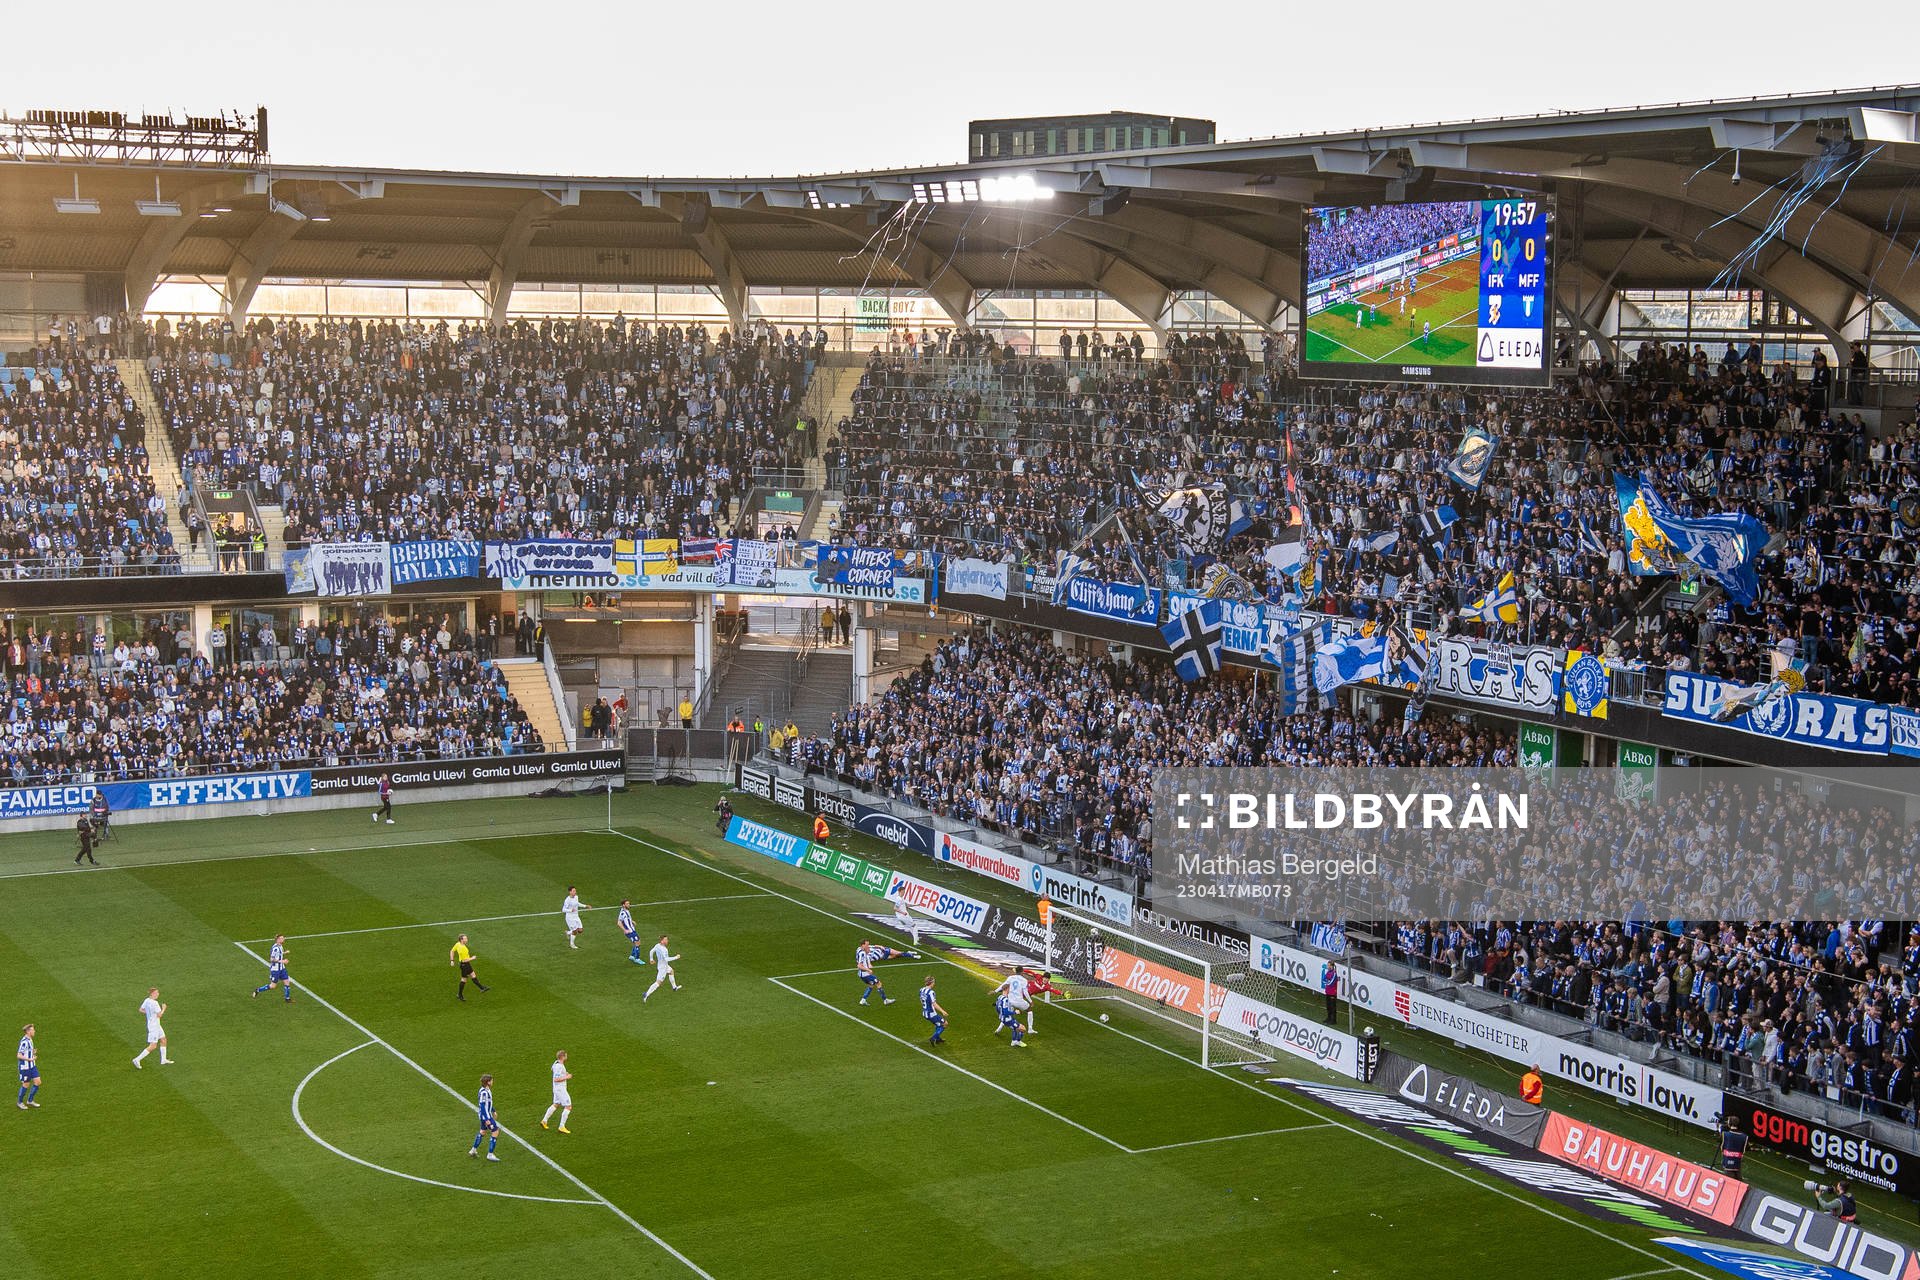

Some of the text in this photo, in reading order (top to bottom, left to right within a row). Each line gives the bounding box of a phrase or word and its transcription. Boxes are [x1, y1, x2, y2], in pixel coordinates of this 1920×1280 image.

[1494, 202, 1536, 226] 19:57
[1492, 238, 1502, 261] 0
[1525, 238, 1535, 261] 0
[1488, 273, 1539, 288] IFK MFF
[862, 300, 916, 313] BACKA BOYZ
[1499, 341, 1541, 358] ELEDA
[1401, 366, 1431, 376] SAMSUNG
[851, 548, 892, 568] HATERS
[661, 572, 684, 582] vad
[686, 572, 703, 583] vill
[848, 568, 892, 586] CORNER
[1576, 698, 1592, 709] BOYS
[472, 763, 545, 779] Gamla Ullevi
[551, 758, 621, 773] Gamla Ullevi
[310, 776, 382, 789] Gamla Ullev
[392, 768, 466, 784] Gamla Ullevi
[0, 785, 97, 810] FAMECO
[149, 774, 300, 806] EFFEKTIV
[32, 807, 65, 816] Kalmbach
[813, 791, 856, 822] Helanders
[736, 819, 798, 857] EFFEKTIV
[876, 823, 909, 848] cuebid
[810, 846, 828, 866] MCR
[838, 856, 856, 875] MCR
[951, 843, 1020, 882] Bergkvarabuss
[865, 867, 884, 887] MCR
[1045, 876, 1128, 922] merinfo.se
[1125, 960, 1191, 1009] Renova
[1411, 1000, 1530, 1055] STENFASTIGHETER
[1559, 1052, 1700, 1120] morris law.
[1434, 1081, 1506, 1127] ELEDA
[1563, 1126, 1723, 1207] BAUHAUS
[1825, 1157, 1897, 1193] Storköksutrustning
